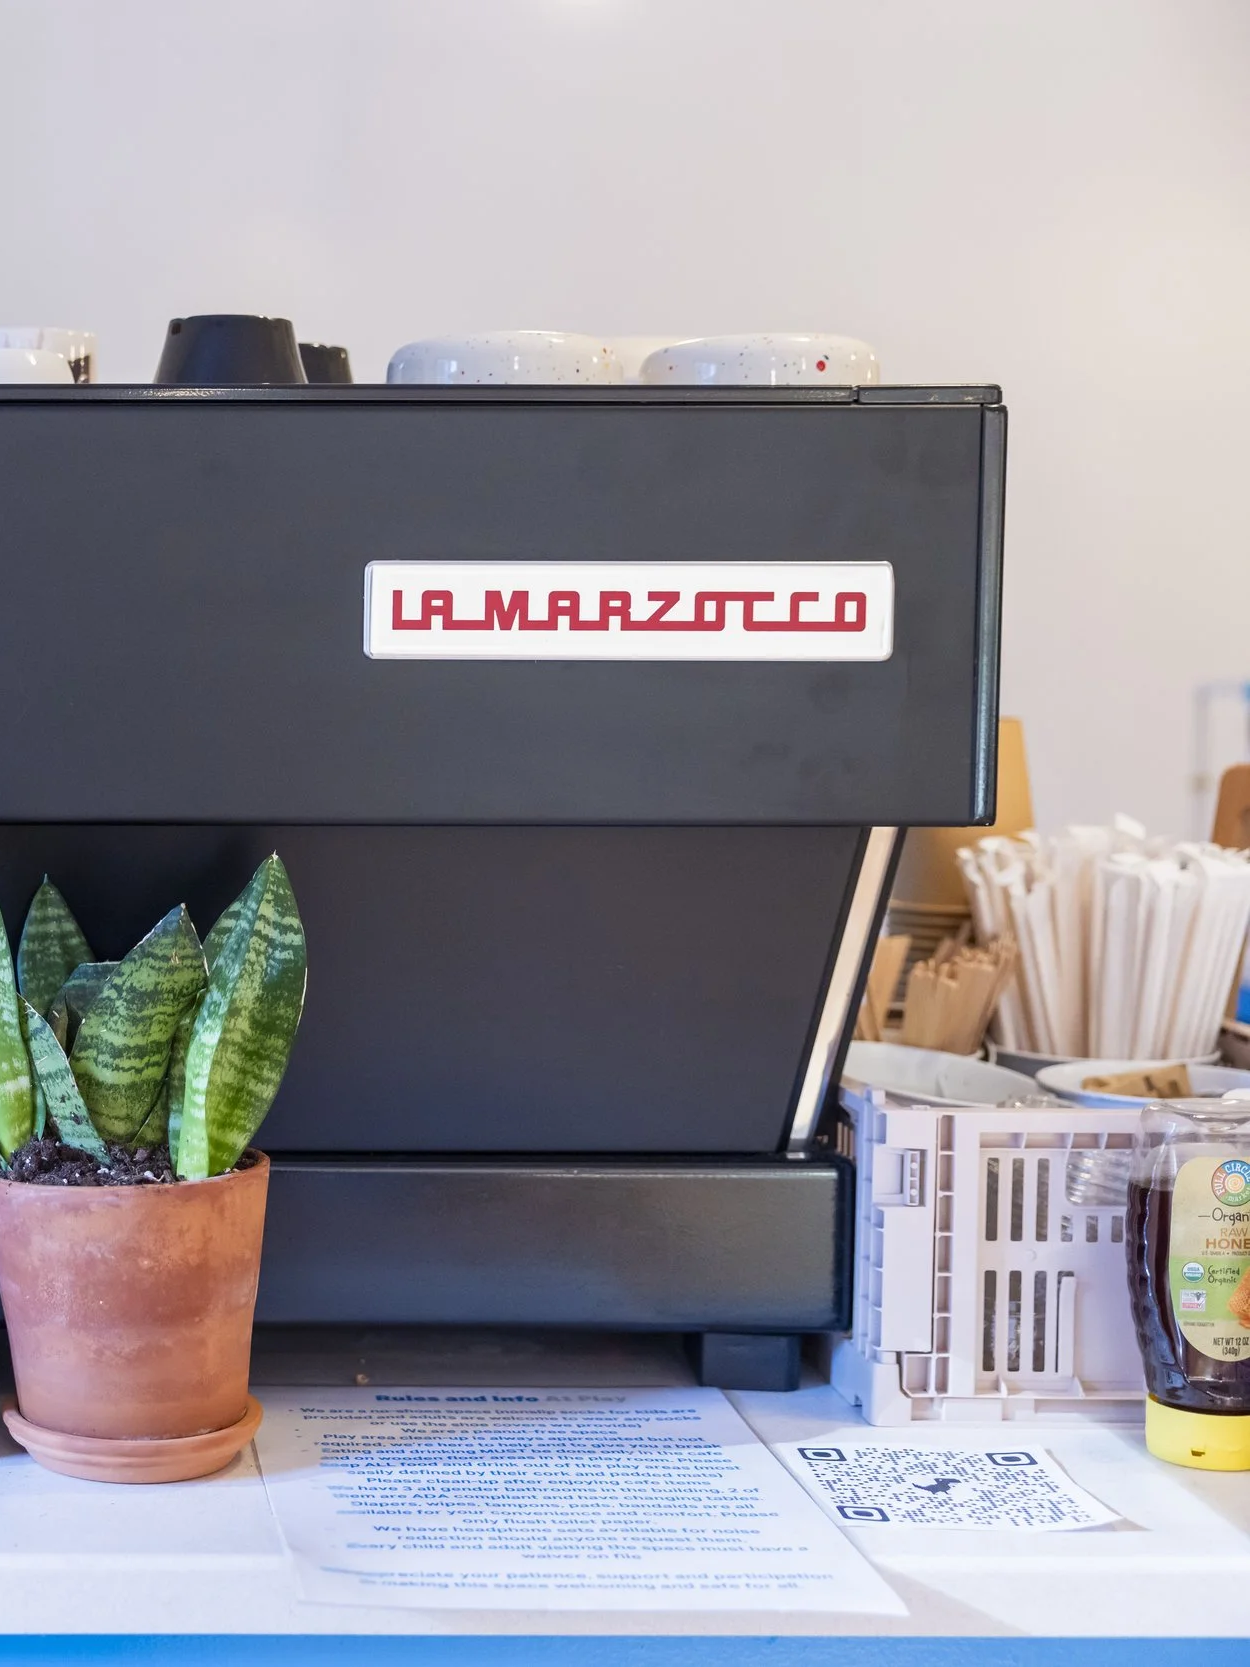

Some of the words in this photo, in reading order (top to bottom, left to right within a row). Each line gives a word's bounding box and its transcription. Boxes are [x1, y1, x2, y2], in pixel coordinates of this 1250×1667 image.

[392, 590, 454, 631] LA
[485, 590, 866, 632] MARZOCCO
[1214, 1172, 1226, 1196] FULL
[1228, 1187, 1250, 1202] marke
[1212, 1207, 1250, 1226] Organ
[1220, 1227, 1248, 1237] RAW
[1205, 1238, 1250, 1249] HONE
[1208, 1265, 1240, 1276] Certified
[1213, 1337, 1224, 1346] NET
[1225, 1337, 1234, 1346] WT
[1235, 1337, 1241, 1346] 12
[1242, 1336, 1249, 1346] OZ
